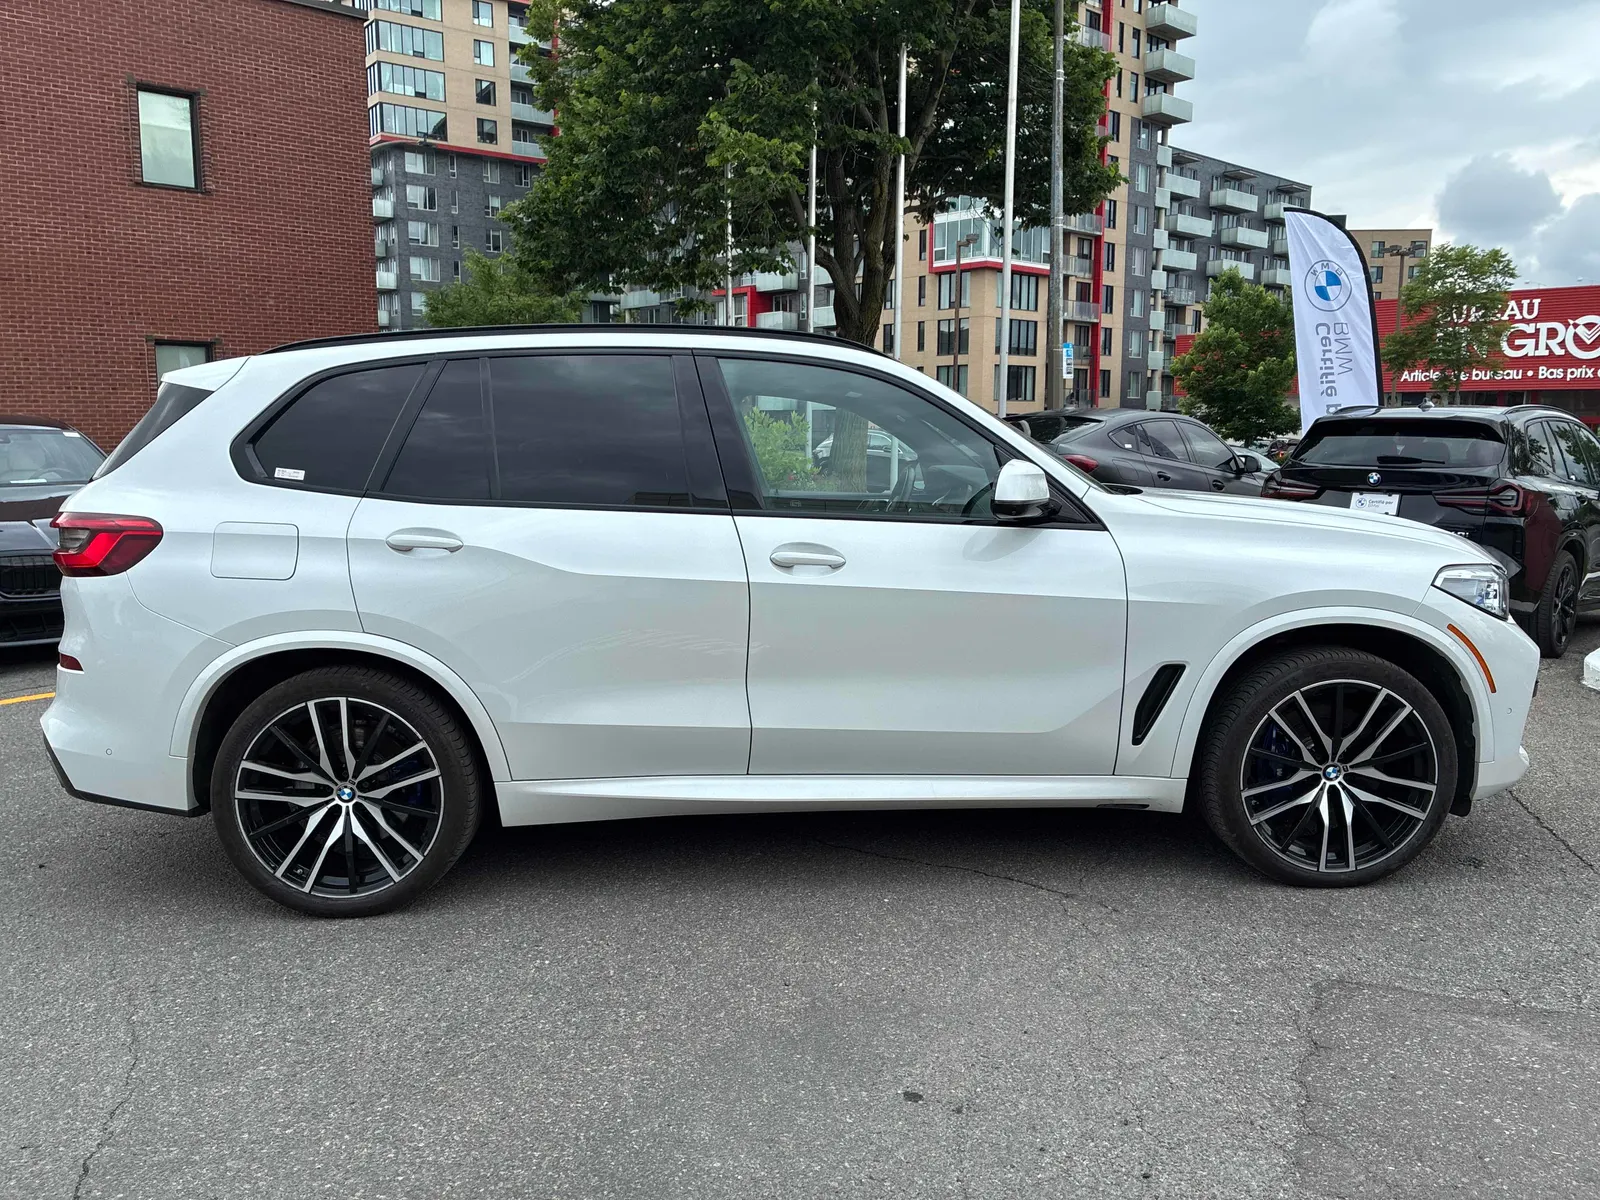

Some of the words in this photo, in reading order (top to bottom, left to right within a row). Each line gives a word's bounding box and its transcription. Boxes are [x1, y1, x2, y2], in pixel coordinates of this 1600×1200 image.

[1437, 299, 1541, 323] URAU
[1400, 369, 1448, 382] Article
[1538, 366, 1564, 379] Bas
[1566, 365, 1595, 381] prix
